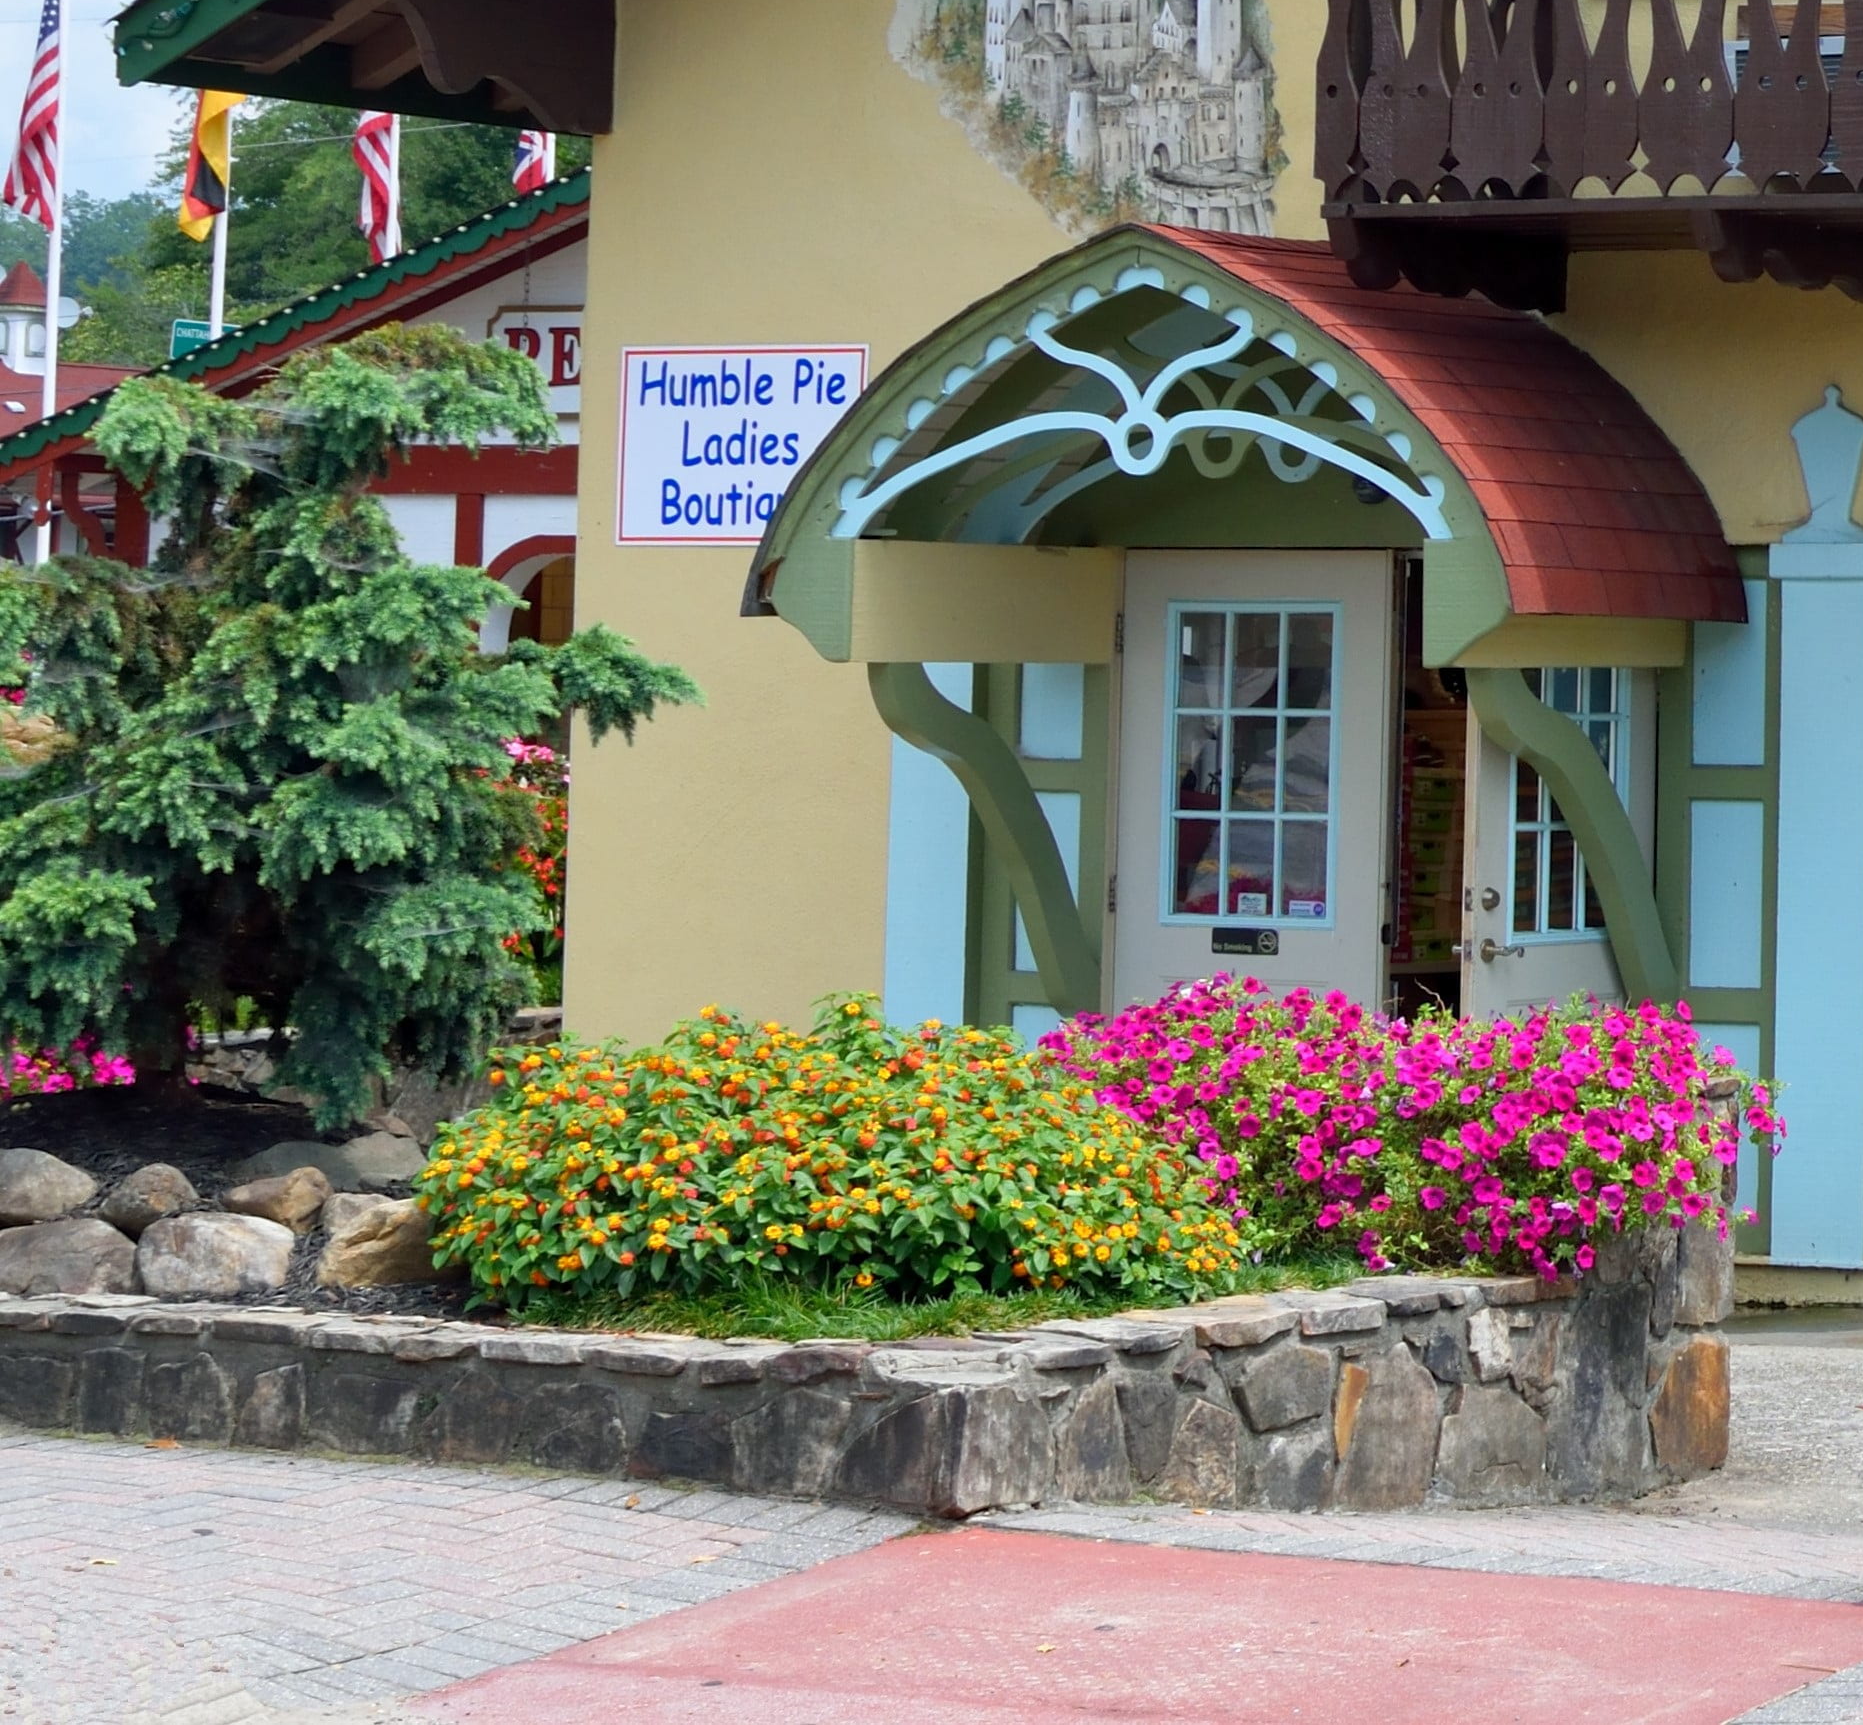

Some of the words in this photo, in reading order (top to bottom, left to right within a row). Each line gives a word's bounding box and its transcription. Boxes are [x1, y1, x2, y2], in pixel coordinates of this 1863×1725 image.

[176, 327, 212, 340] CHATTAH
[640, 358, 774, 408] Humble
[794, 358, 846, 405] Pie
[682, 418, 799, 467] Ladies
[661, 478, 783, 526] Boutiq
[1223, 942, 1253, 953] Smoking
